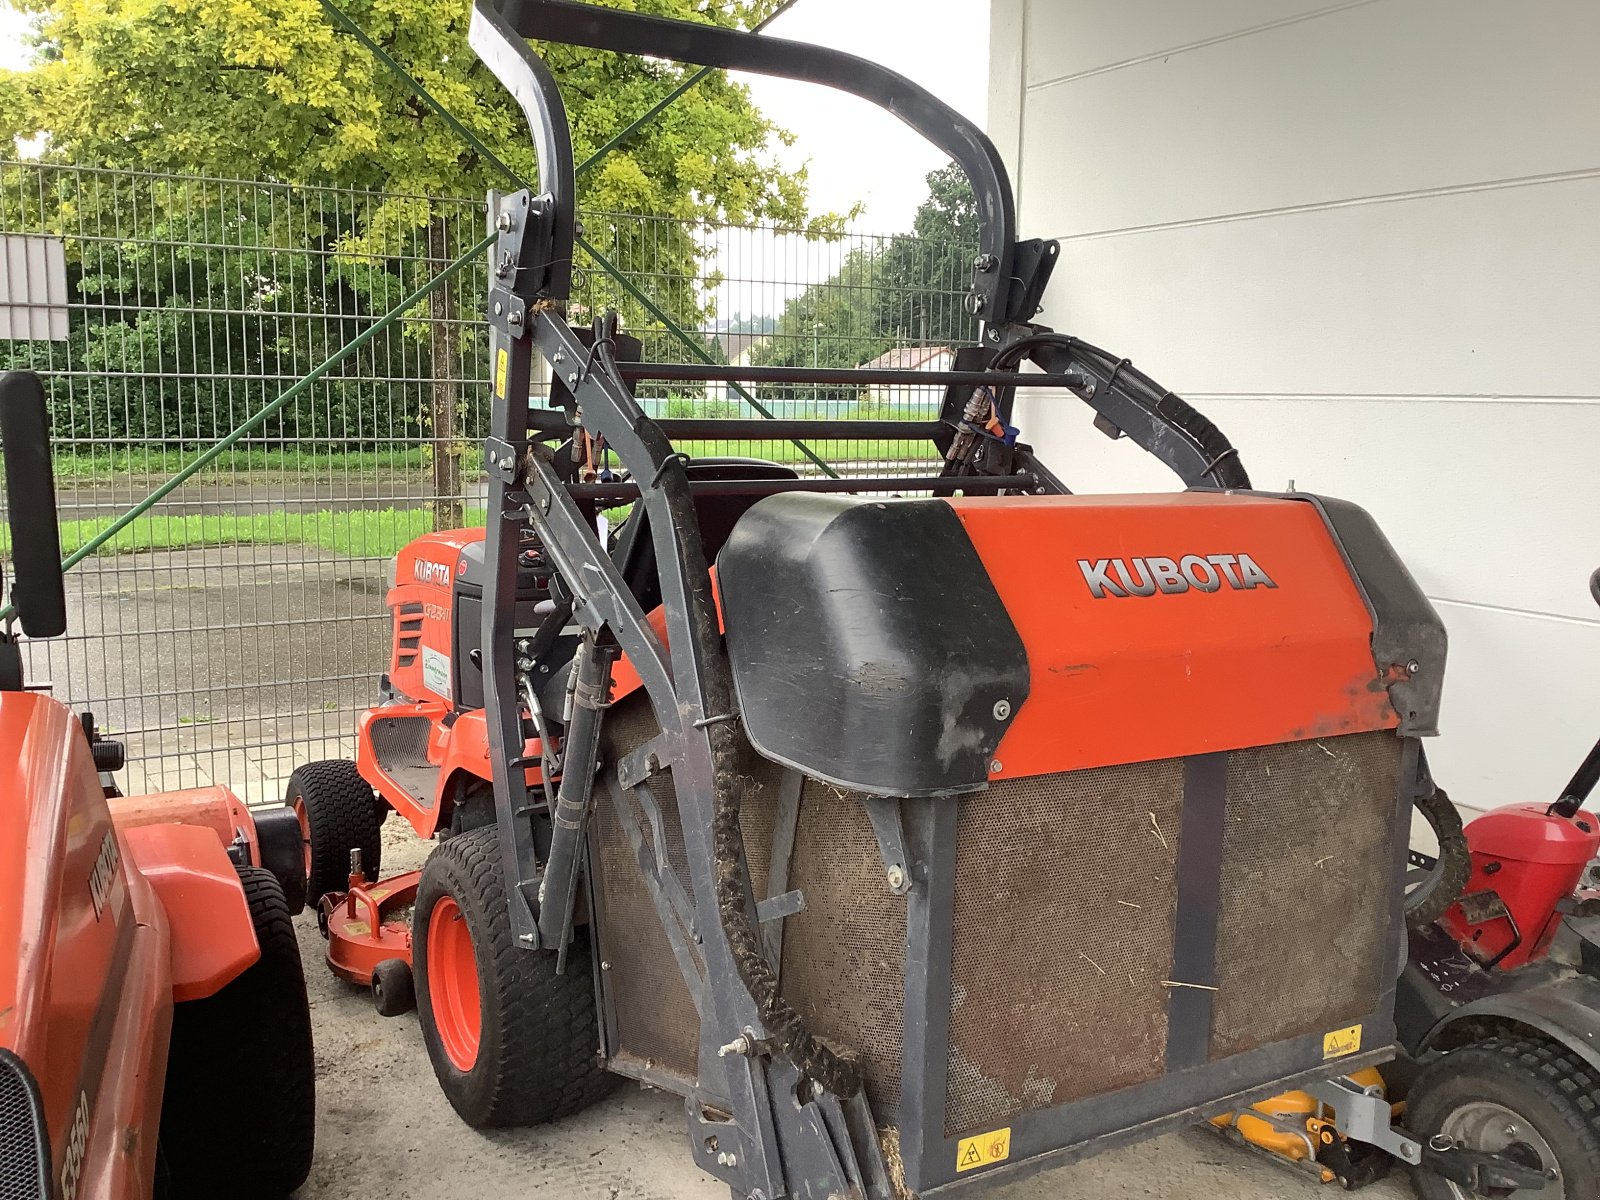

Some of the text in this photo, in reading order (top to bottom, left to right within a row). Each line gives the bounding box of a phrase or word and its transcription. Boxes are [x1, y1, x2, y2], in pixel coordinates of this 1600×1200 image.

[414, 558, 450, 587] KUBOTA
[1077, 553, 1279, 599] KUBOTA
[88, 828, 118, 923] KUBOTA
